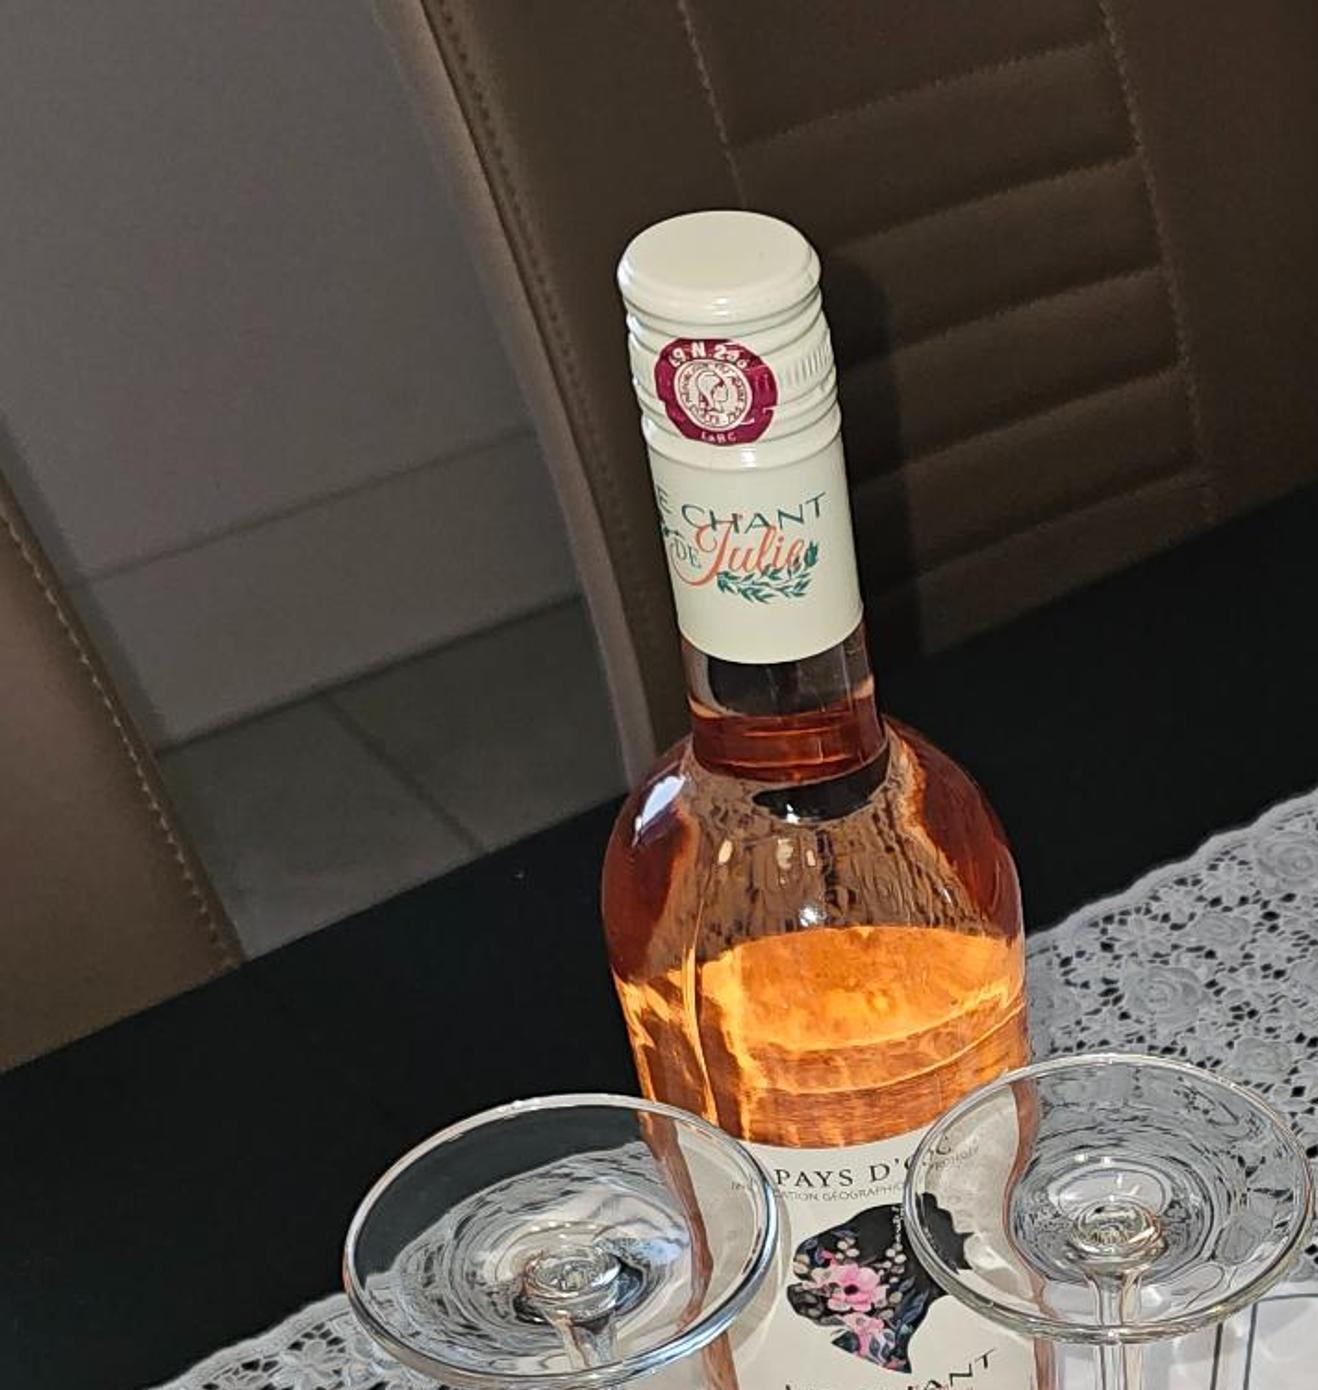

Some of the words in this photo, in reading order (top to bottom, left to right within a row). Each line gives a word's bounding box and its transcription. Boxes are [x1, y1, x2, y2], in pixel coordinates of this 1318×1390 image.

[682, 491, 826, 534] CHANT
[671, 521, 805, 586] Julie
[774, 1167, 854, 1189] PAYS
